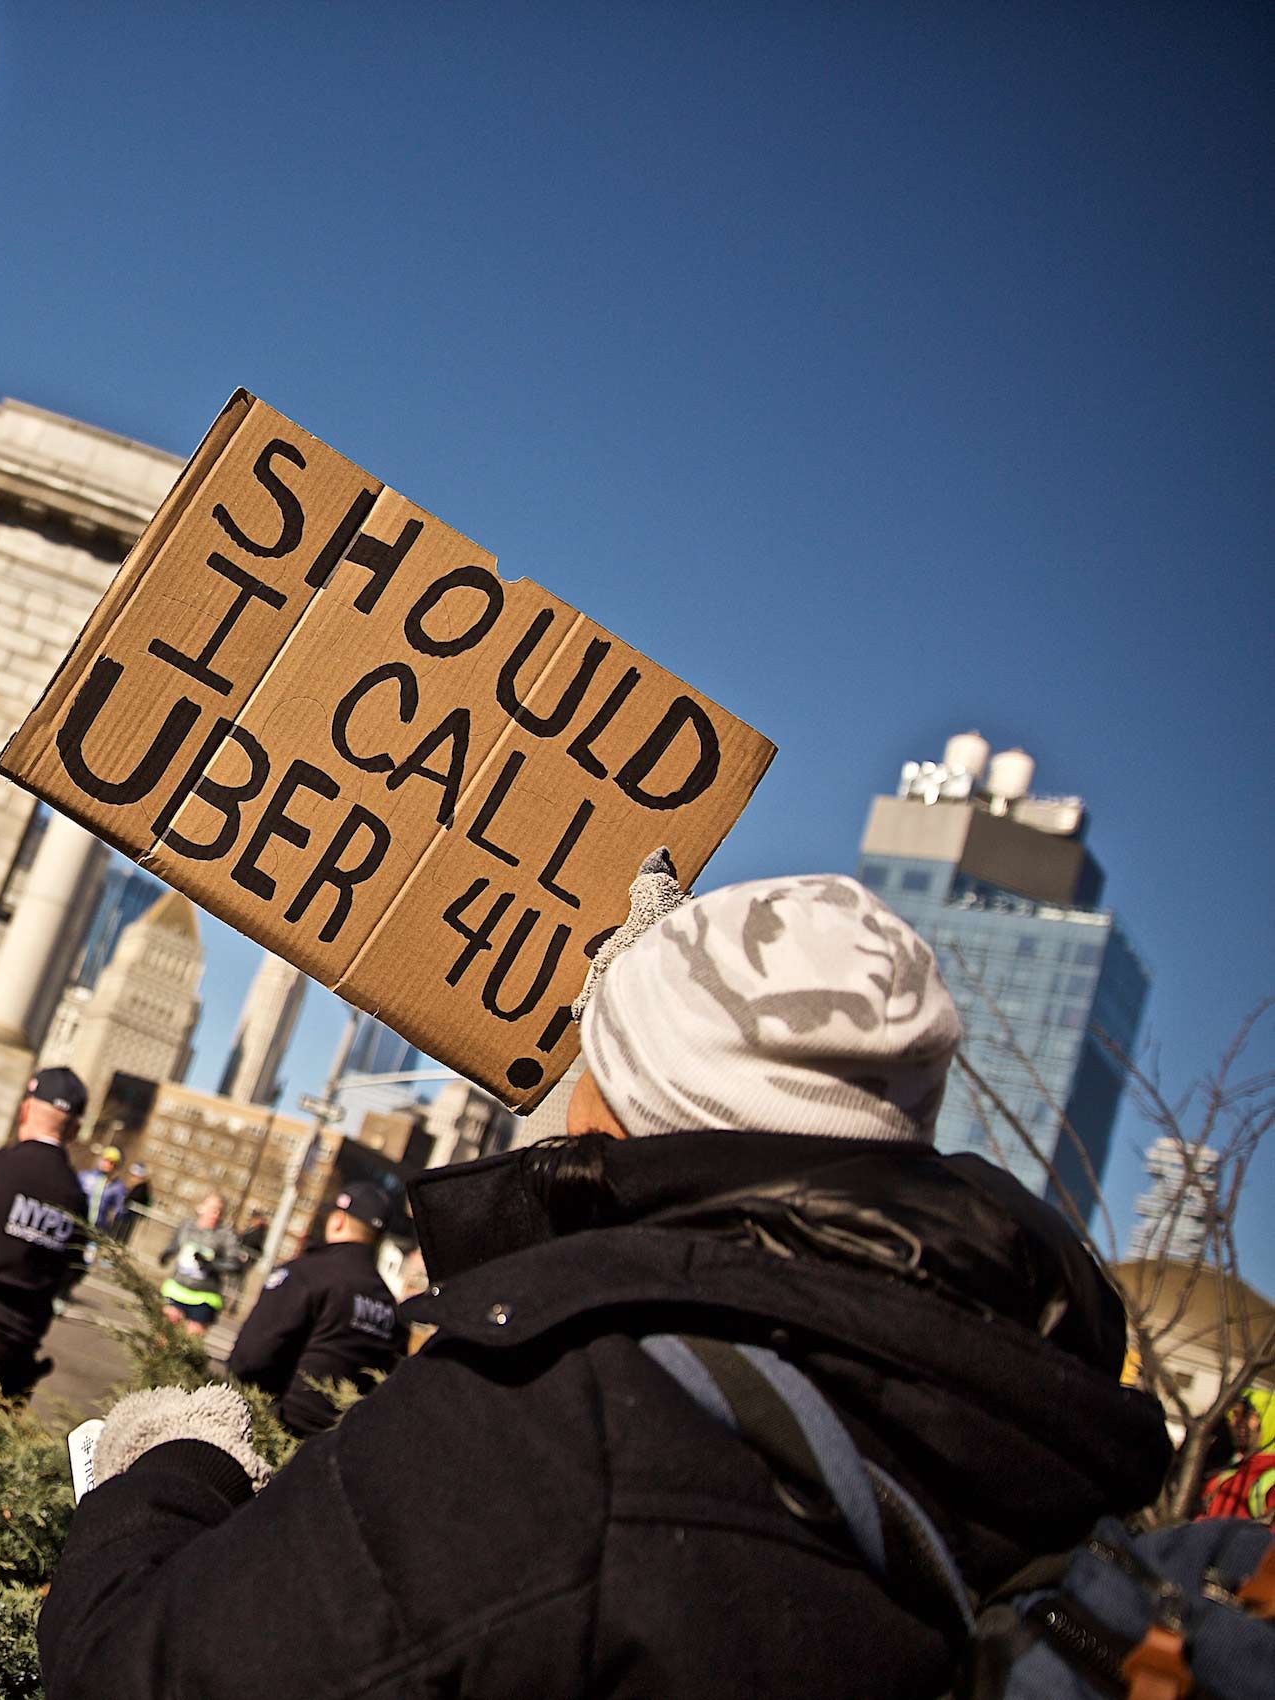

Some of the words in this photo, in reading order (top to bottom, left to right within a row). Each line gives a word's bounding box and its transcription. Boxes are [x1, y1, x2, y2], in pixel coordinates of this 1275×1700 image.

[148, 551, 288, 697] I
[331, 662, 597, 911] CALL
[212, 438, 723, 813] SHOULD
[55, 656, 392, 944] UBER
[7, 1193, 75, 1239] NYPD
